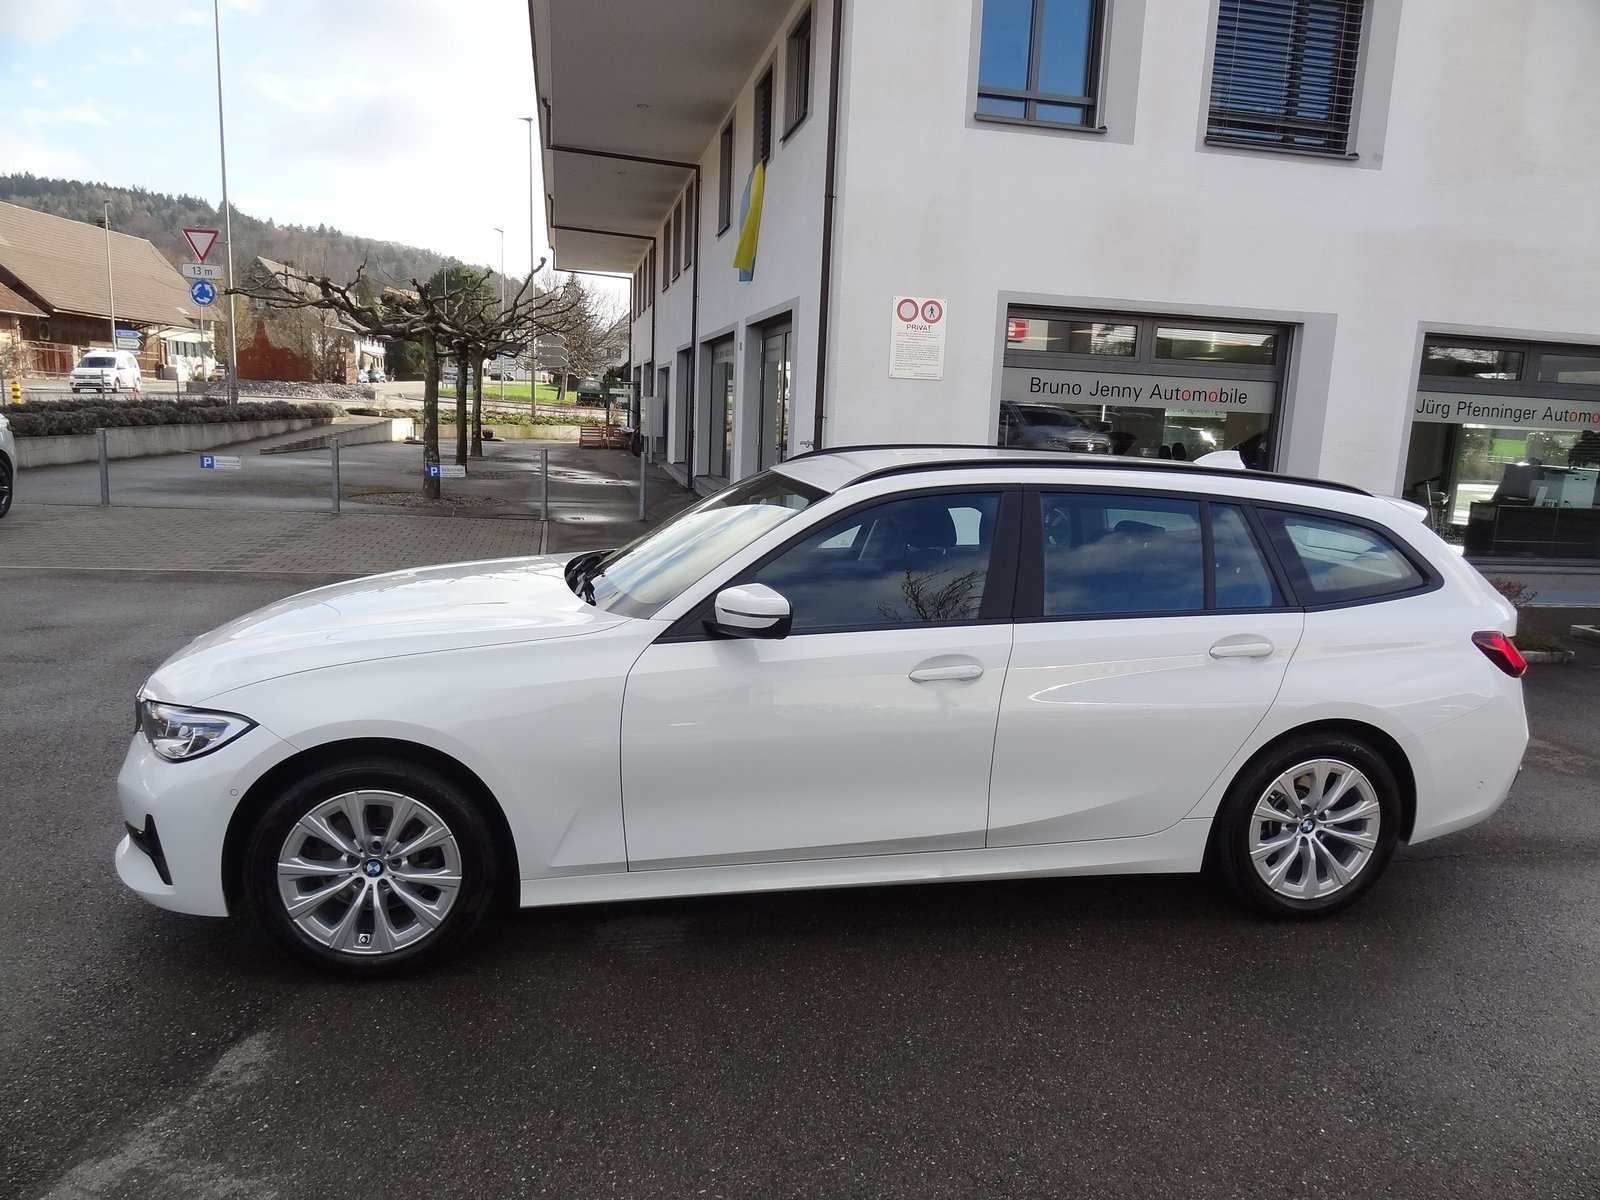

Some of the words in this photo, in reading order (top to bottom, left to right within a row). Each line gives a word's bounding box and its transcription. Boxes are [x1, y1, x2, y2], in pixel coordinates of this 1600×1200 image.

[192, 267, 202, 276] 13
[1029, 376, 1082, 396] Bruno
[1089, 380, 1143, 402] Jenny
[1149, 384, 1248, 404] Automobile
[1416, 398, 1451, 419] Jürg
[1456, 401, 1537, 423] Pfenninger
[1542, 406, 1600, 424] Automo
[203, 457, 212, 467] P
[430, 466, 438, 477] P
